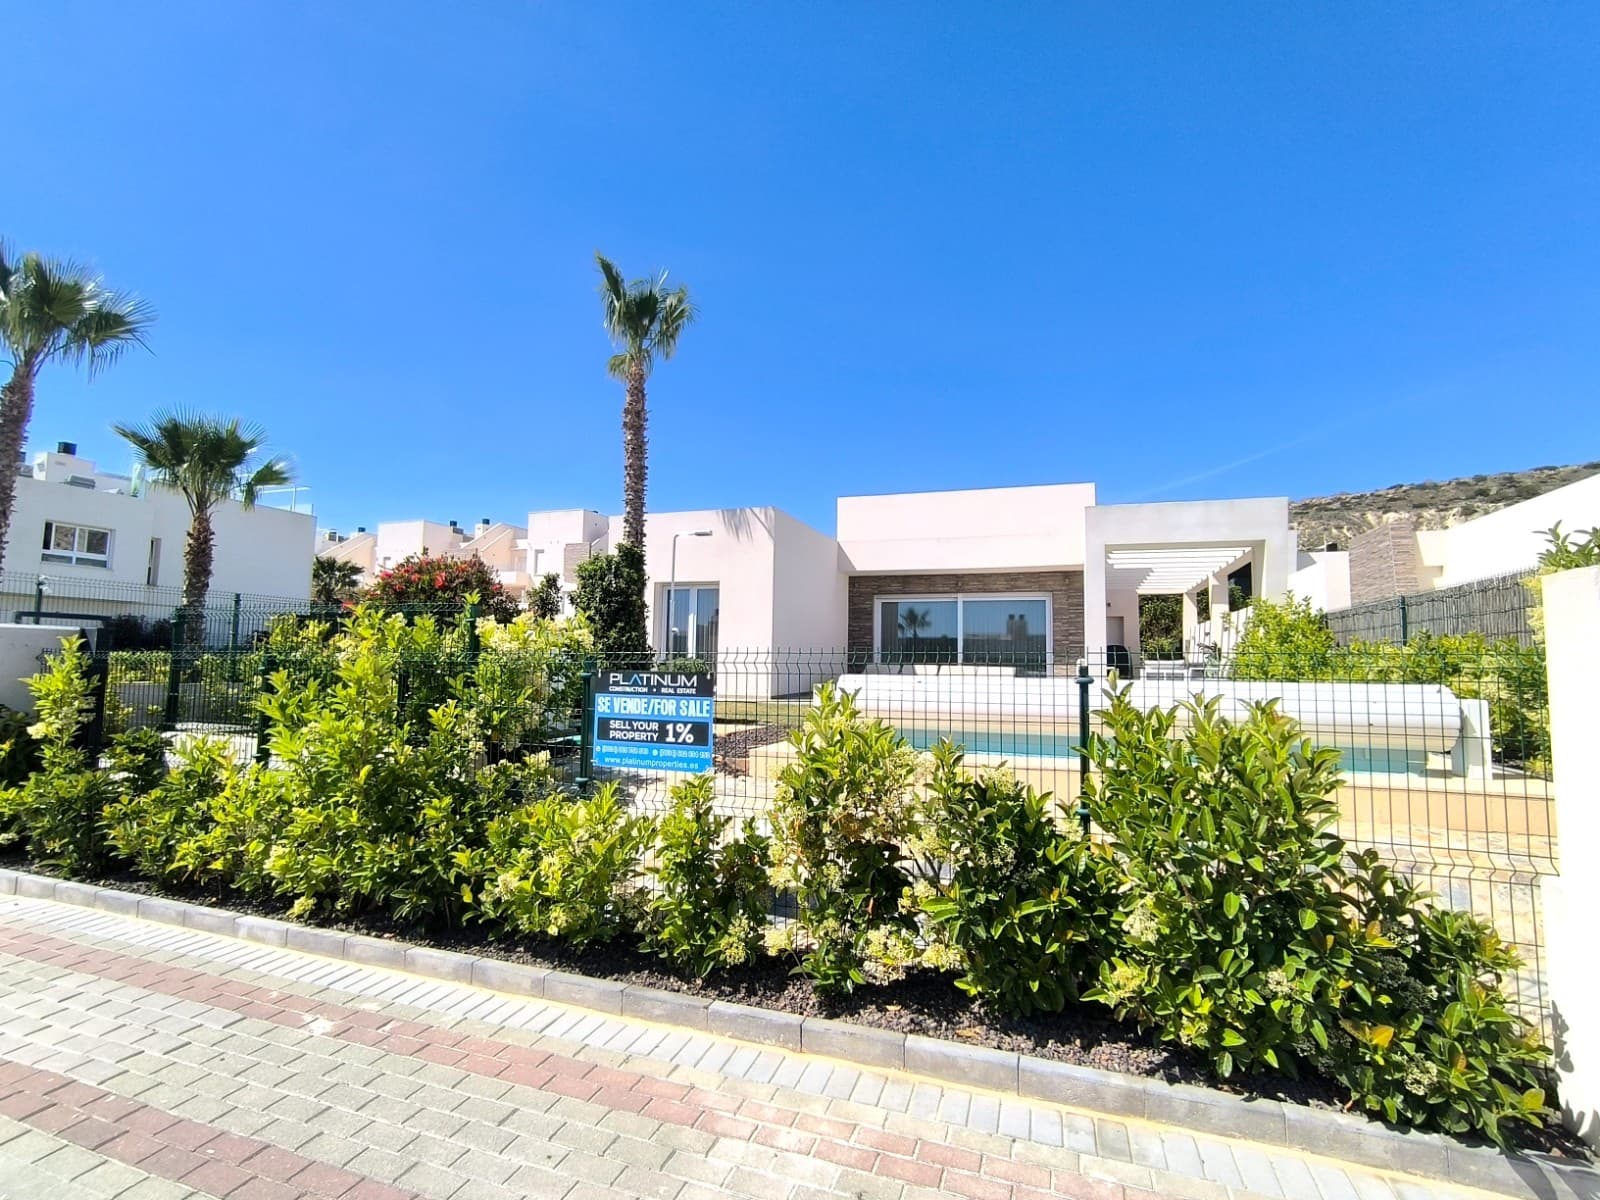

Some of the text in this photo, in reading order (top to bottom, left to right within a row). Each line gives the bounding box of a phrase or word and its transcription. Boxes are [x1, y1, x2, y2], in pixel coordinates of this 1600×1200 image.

[609, 673, 697, 686] PLATINUM
[598, 696, 710, 717] SE VENDE/FOR SALE
[609, 720, 659, 731] SELL YOUR
[609, 731, 658, 741] PROPERTY
[665, 723, 694, 743] 1%
[605, 757, 699, 768] www.platinumproperties.es
